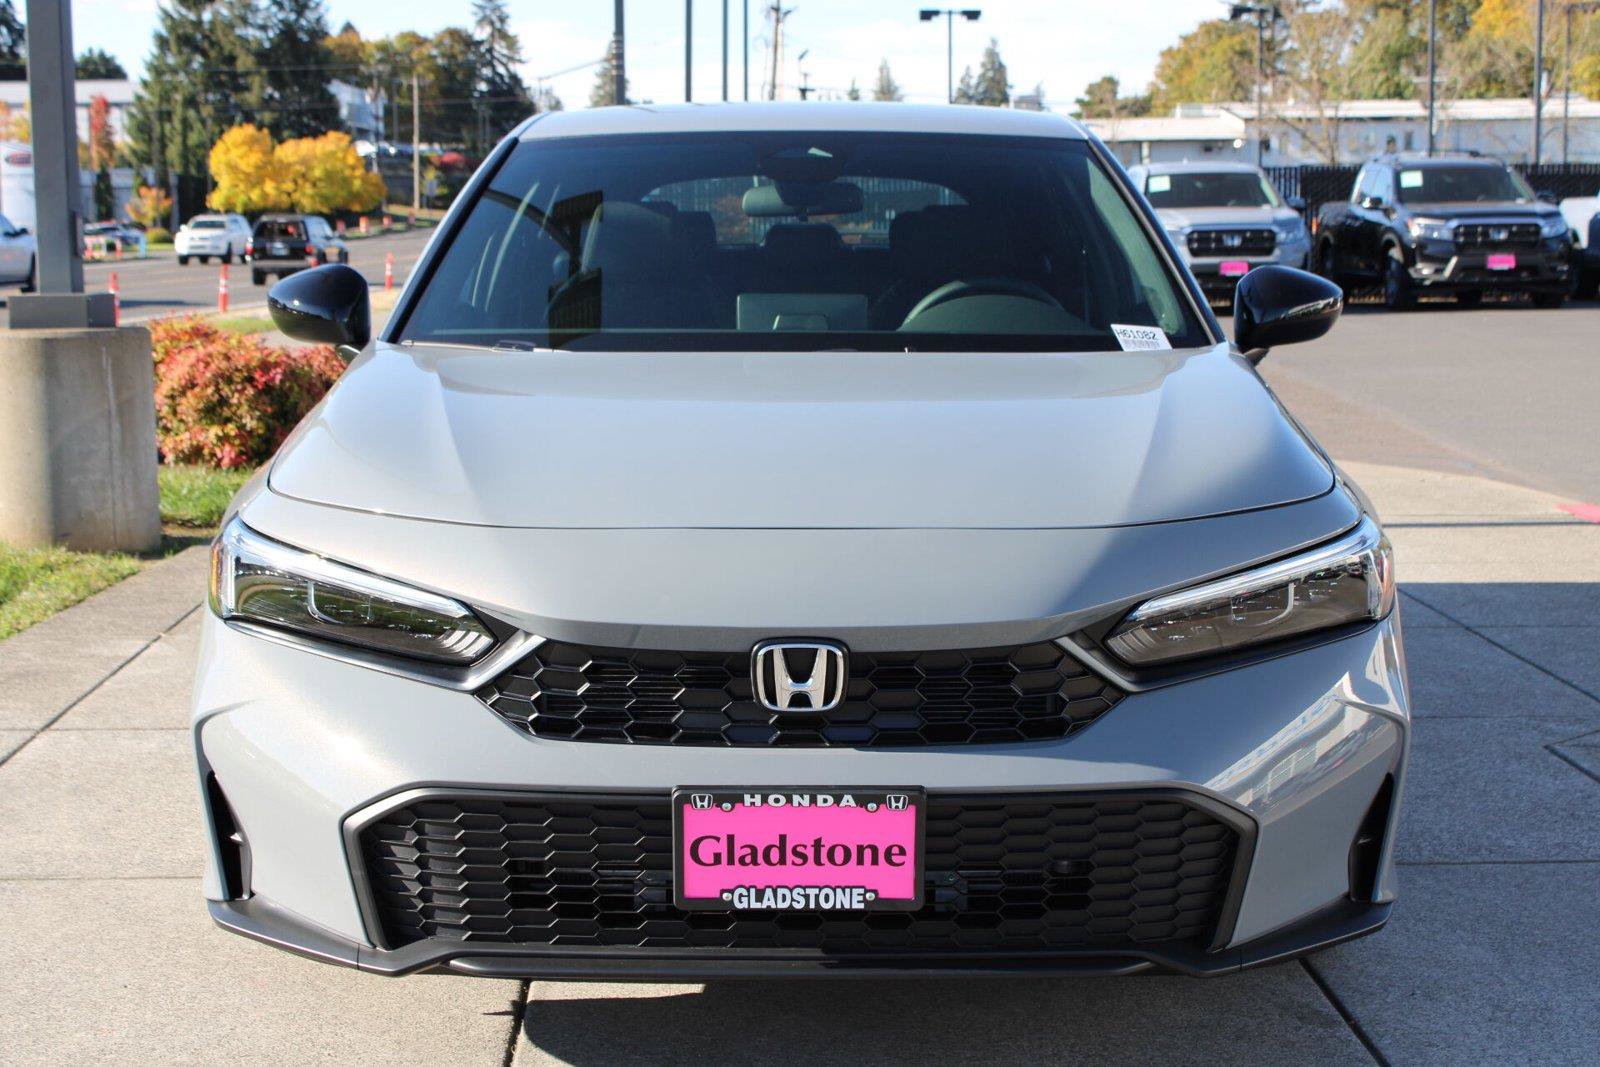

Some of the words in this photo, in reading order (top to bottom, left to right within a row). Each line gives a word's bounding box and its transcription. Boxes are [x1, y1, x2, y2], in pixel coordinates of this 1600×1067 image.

[743, 793, 857, 807] HONDA
[689, 834, 907, 867] Gladstone
[733, 888, 865, 909] GLADSTONE
